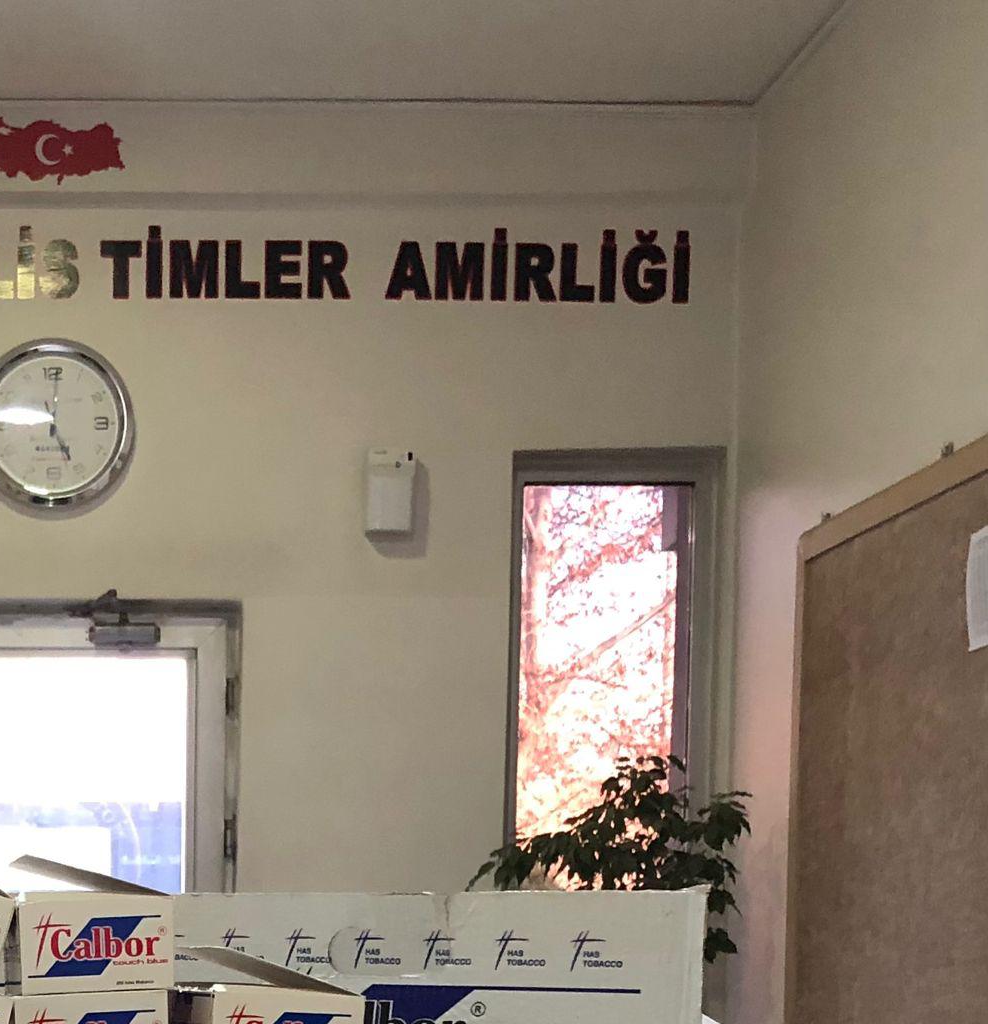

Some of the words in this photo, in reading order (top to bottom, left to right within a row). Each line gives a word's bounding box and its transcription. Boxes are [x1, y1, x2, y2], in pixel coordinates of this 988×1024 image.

[100, 224, 351, 301] TİMLER
[385, 227, 691, 305] AMİRLİĞİ
[94, 416, 109, 430] 3
[50, 926, 160, 960] Calbor
